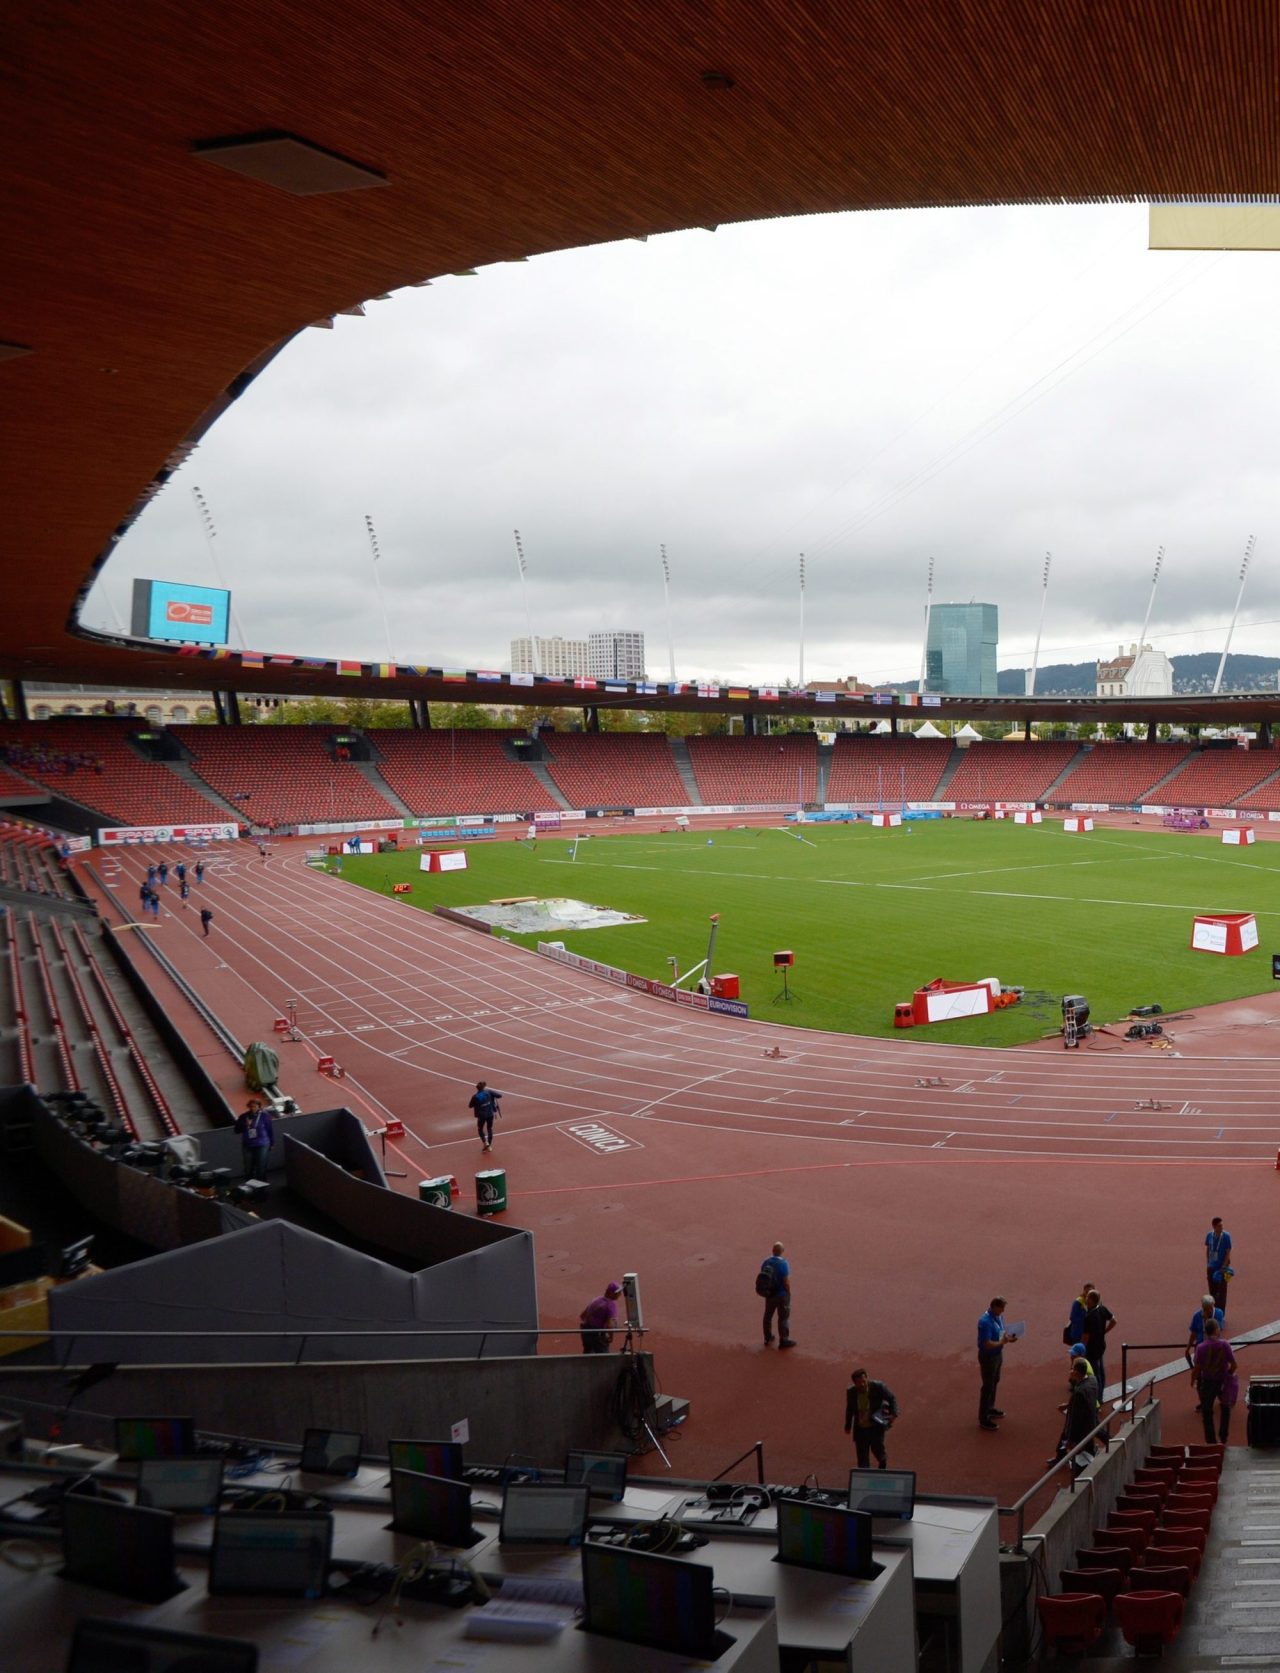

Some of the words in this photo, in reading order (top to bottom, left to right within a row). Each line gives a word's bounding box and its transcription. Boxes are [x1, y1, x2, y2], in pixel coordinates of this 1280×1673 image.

[116, 831, 155, 840] SPAR
[185, 828, 222, 837] SPAR
[709, 999, 747, 1015] EUROVISION
[568, 1123, 631, 1153] CONICA
